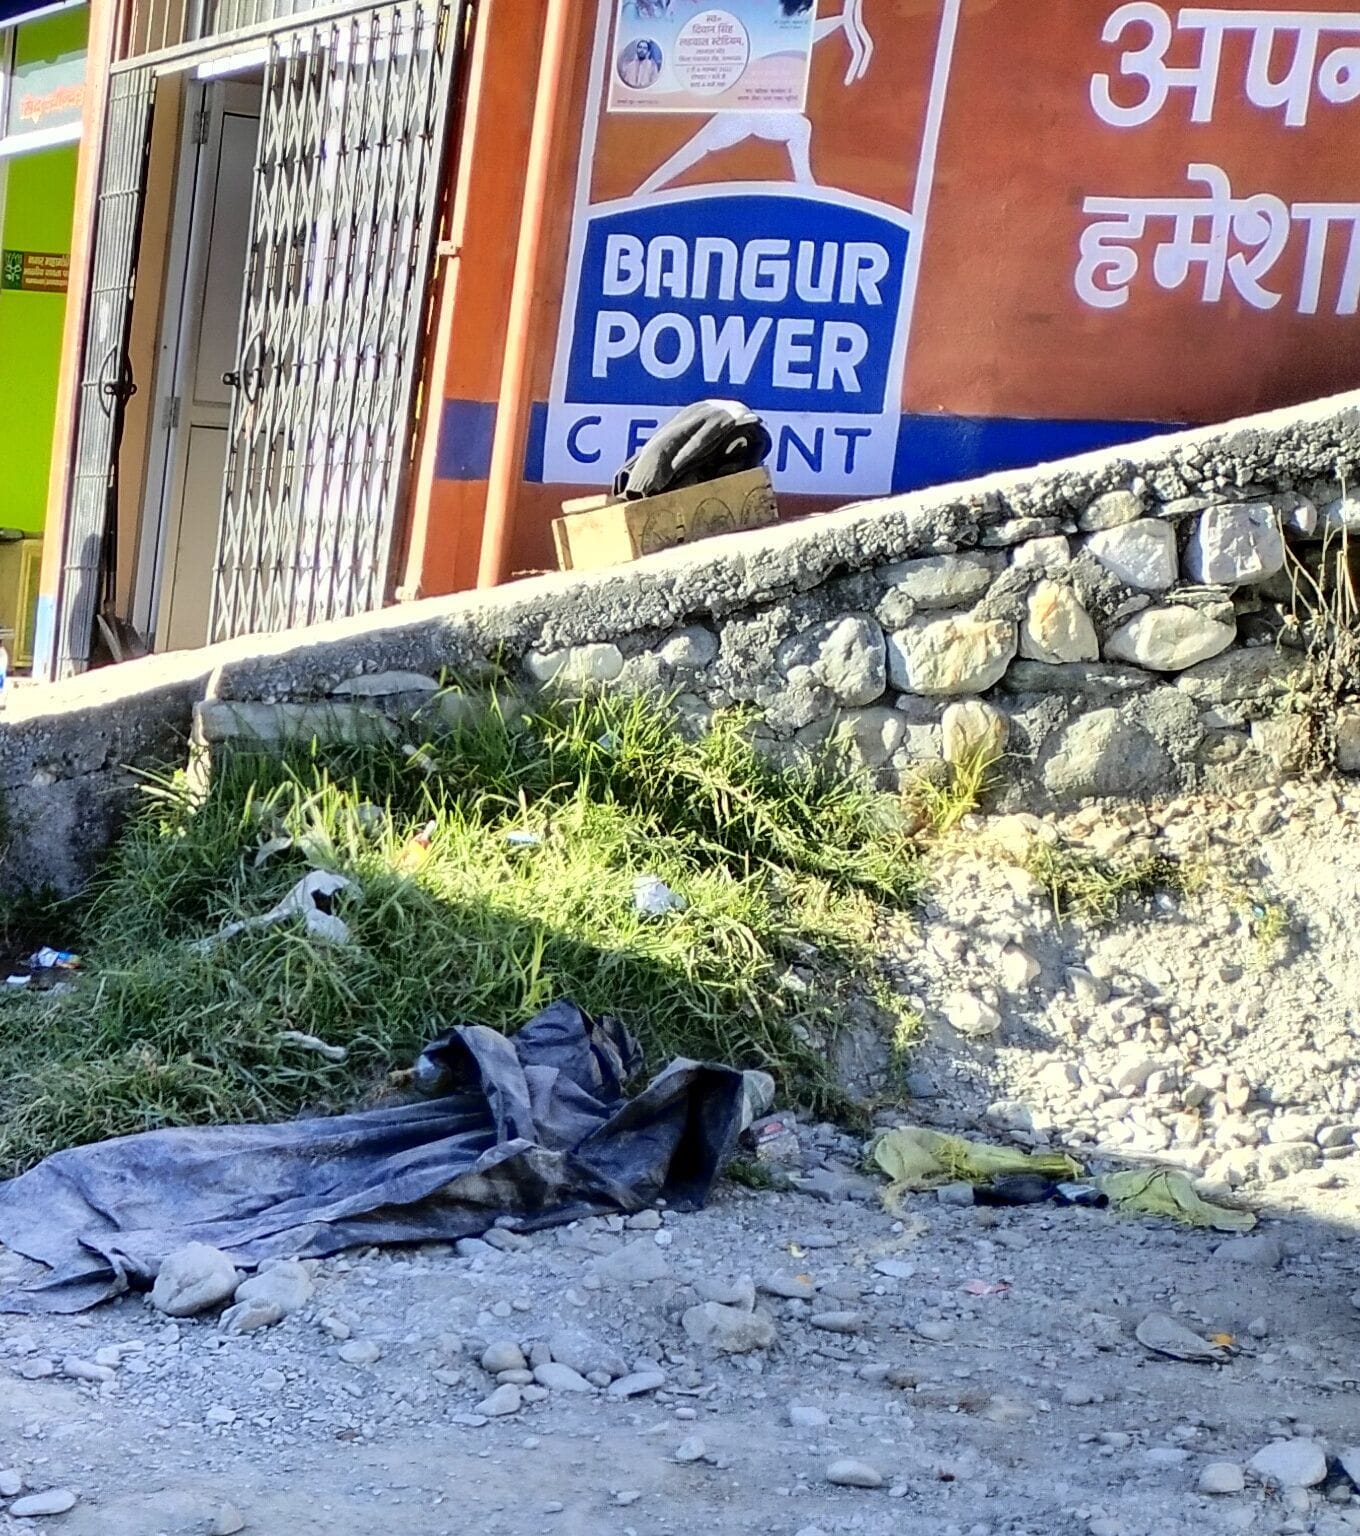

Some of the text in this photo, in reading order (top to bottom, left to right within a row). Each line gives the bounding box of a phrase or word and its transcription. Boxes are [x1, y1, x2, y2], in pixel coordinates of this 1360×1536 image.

[602, 233, 890, 305] BANGUR
[1075, 164, 1360, 314] हमेशा
[591, 310, 870, 393] POWER
[566, 415, 872, 475] CENT
